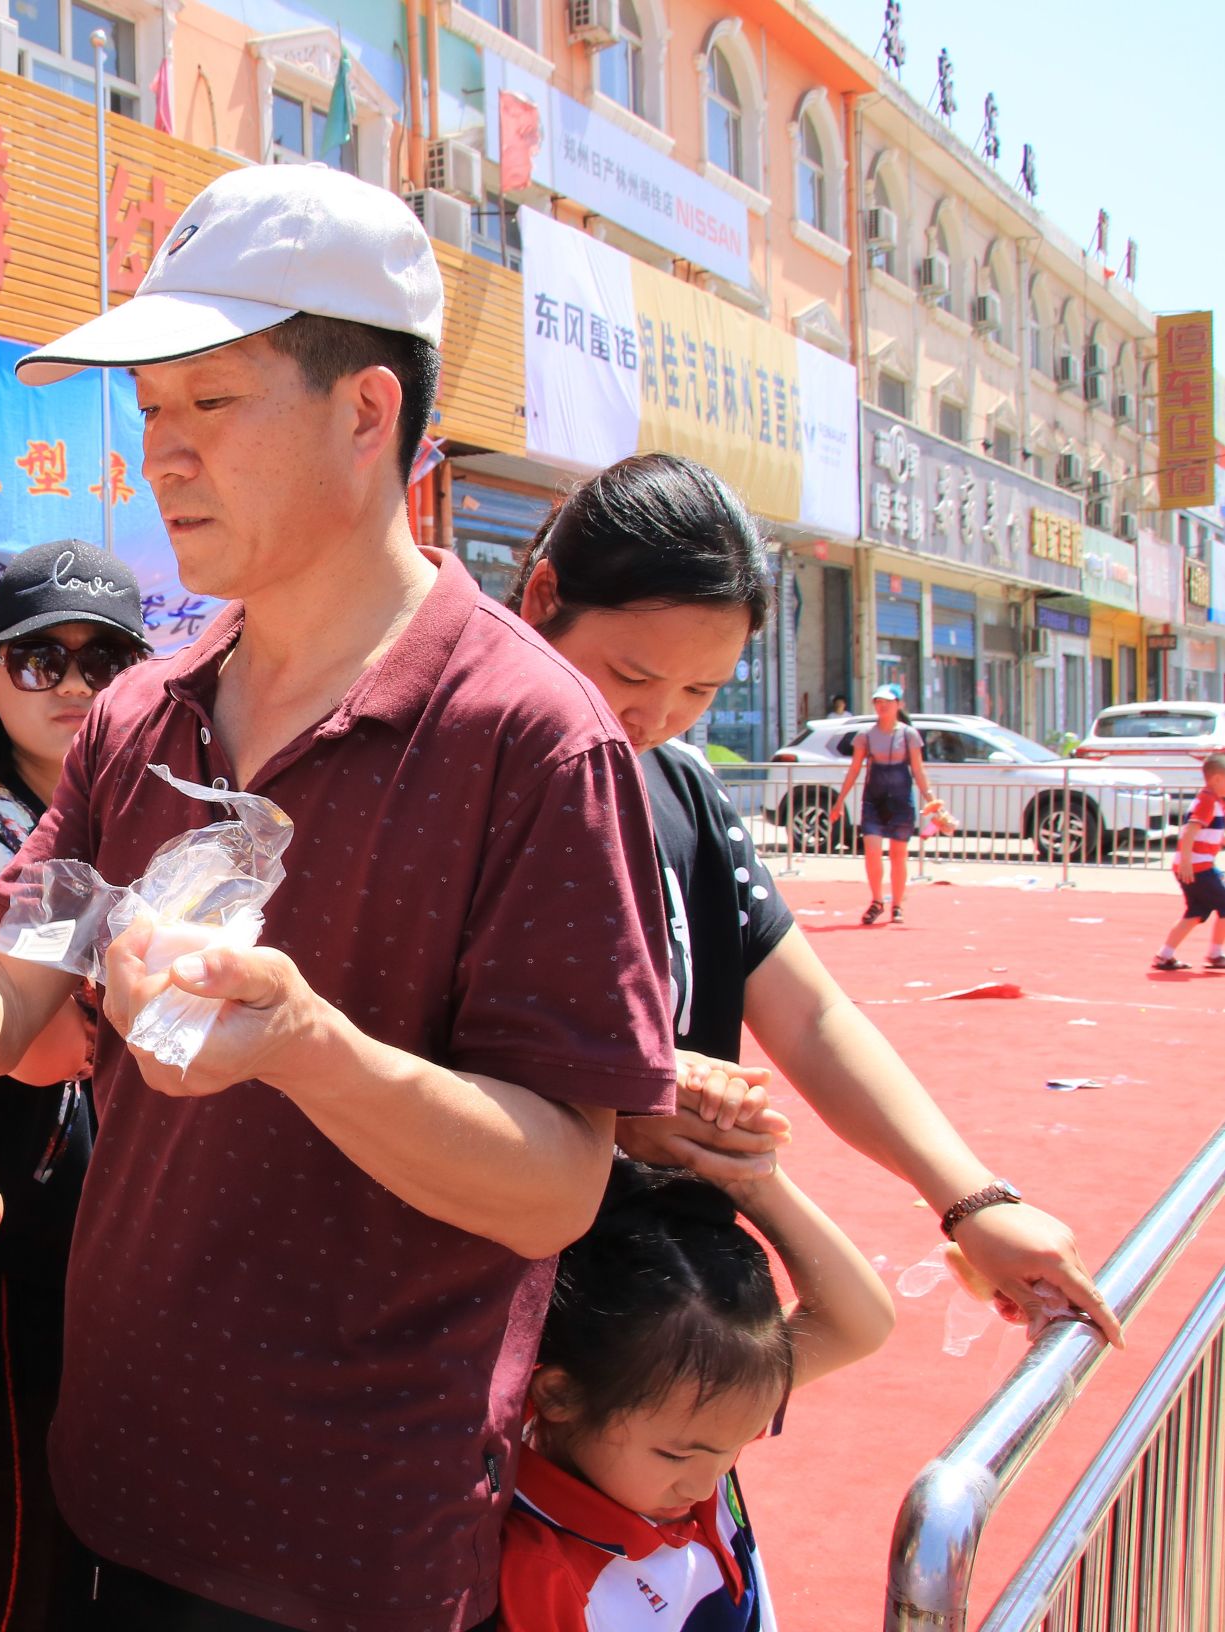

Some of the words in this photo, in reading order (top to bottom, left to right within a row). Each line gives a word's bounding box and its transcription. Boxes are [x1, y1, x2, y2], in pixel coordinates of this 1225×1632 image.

[676, 196, 742, 257] NISSAN
[534, 292, 637, 371] 东风雷诺
[1166, 323, 1209, 498] 停车住宿
[15, 551, 131, 597] love
